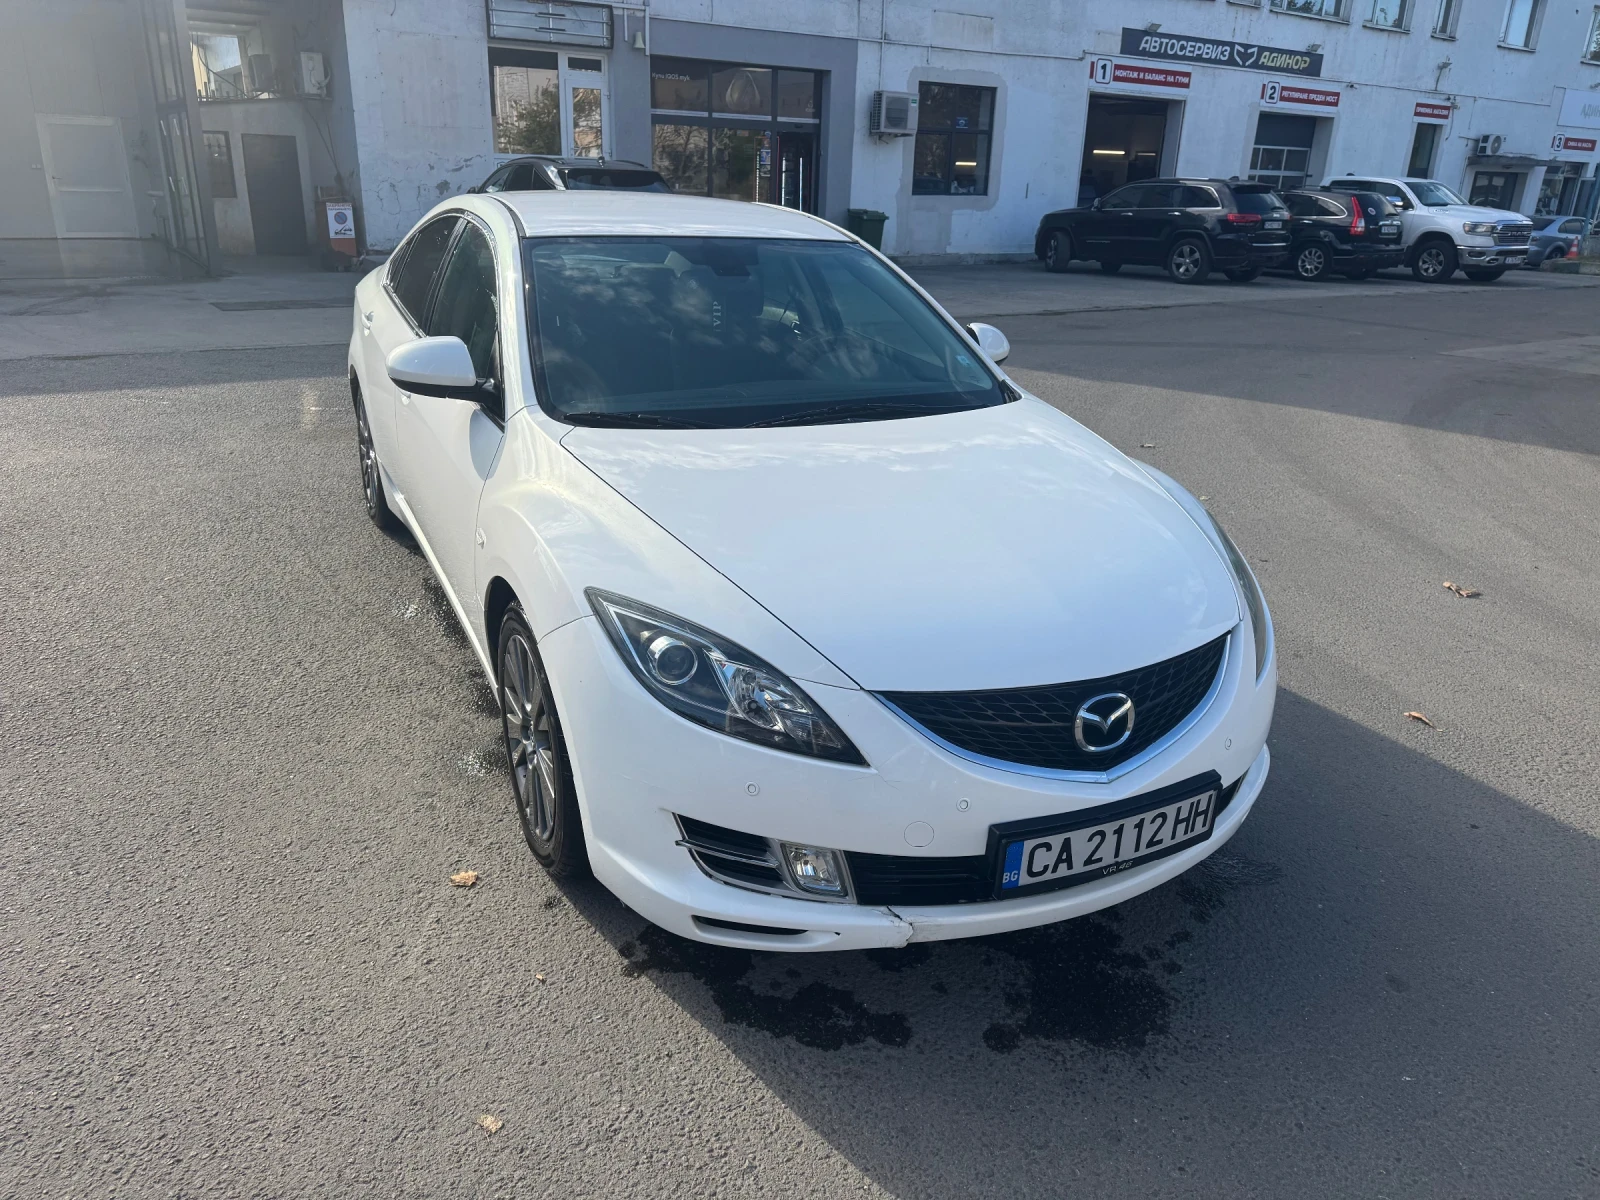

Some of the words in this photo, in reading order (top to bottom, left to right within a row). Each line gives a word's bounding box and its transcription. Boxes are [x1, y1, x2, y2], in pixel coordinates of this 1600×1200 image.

[1139, 35, 1230, 61] АВТОСЕРВИЗ
[1259, 51, 1310, 70] АДИНОР
[1100, 63, 1107, 80] 1
[1114, 69, 1138, 79] МОНТАЖ
[1144, 72, 1166, 82] БАЛАНС
[1175, 76, 1190, 84] ГУМИ
[1268, 85, 1276, 100] 2
[1556, 137, 1562, 148] 3
[1026, 836, 1074, 878] CA
[1083, 811, 1168, 867] 2112
[1170, 794, 1214, 840] HH
[1002, 872, 1018, 884] BG
